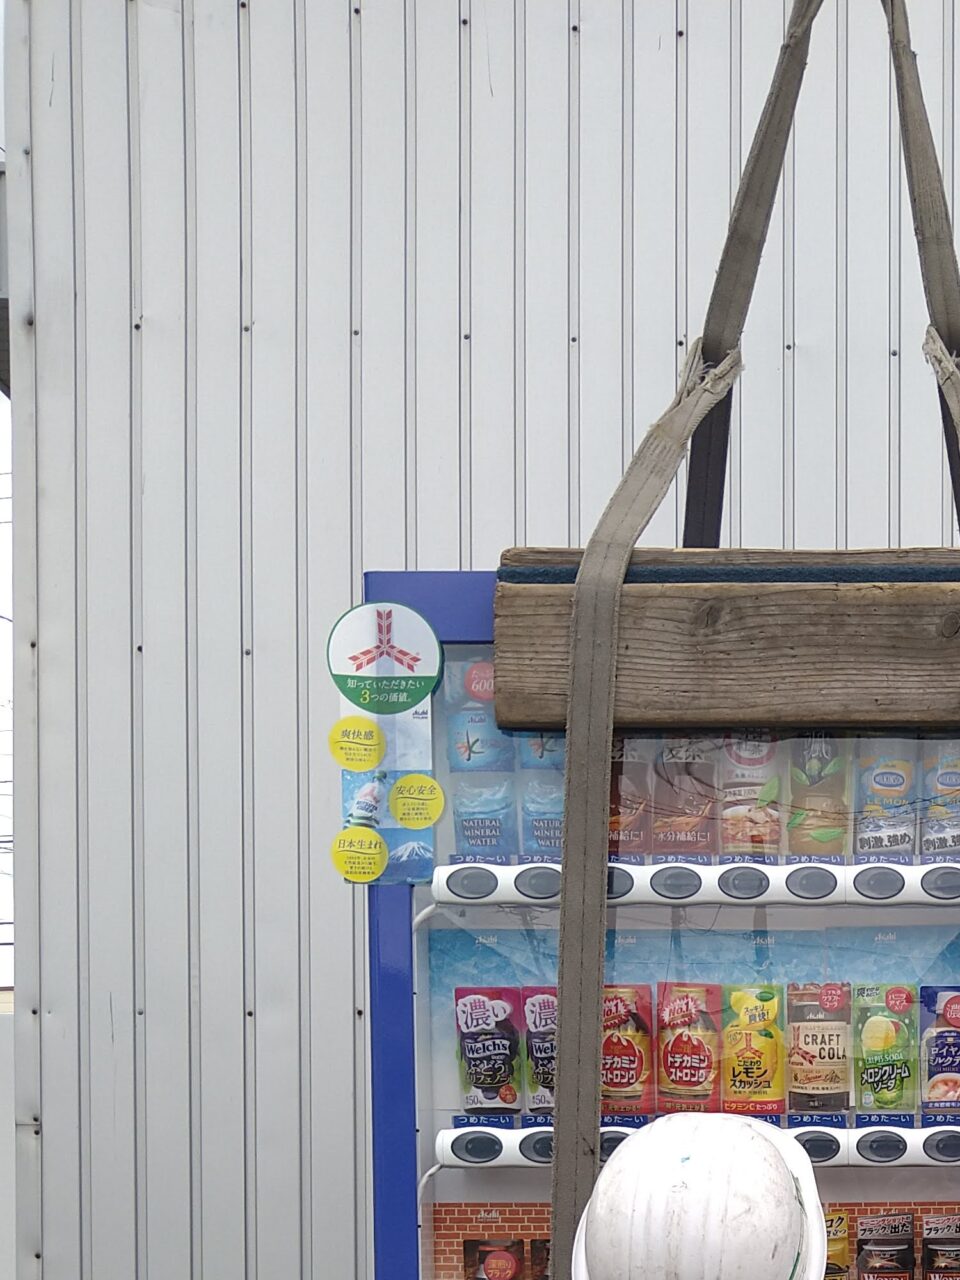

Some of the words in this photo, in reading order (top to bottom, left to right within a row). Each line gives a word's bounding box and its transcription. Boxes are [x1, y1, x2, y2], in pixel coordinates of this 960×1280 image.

[346, 678, 425, 689] 知っていただきたい
[341, 729, 375, 741] 爽快感
[396, 785, 437, 796] 安心安全
[463, 819, 501, 828] NATURAL
[464, 829, 501, 837] MINERAL
[338, 838, 382, 850] 日本生まれ
[469, 838, 498, 846] WATER
[538, 838, 565, 847] WATE
[461, 998, 507, 1031] 濃い
[529, 998, 557, 1031] 濃
[669, 1000, 691, 1018] No.1
[803, 1033, 841, 1046] CRAFT
[466, 1041, 508, 1056] Welch's
[818, 1046, 847, 1060] COLA
[467, 1060, 505, 1074] ぶどう
[732, 1066, 768, 1079] レモン
[861, 1063, 910, 1084] メロンクリーム
[729, 1079, 772, 1089] スカッシュ
[873, 1079, 896, 1093] ソーダ
[724, 1102, 755, 1111] ビタミンC
[600, 1115, 644, 1123] めた〜い
